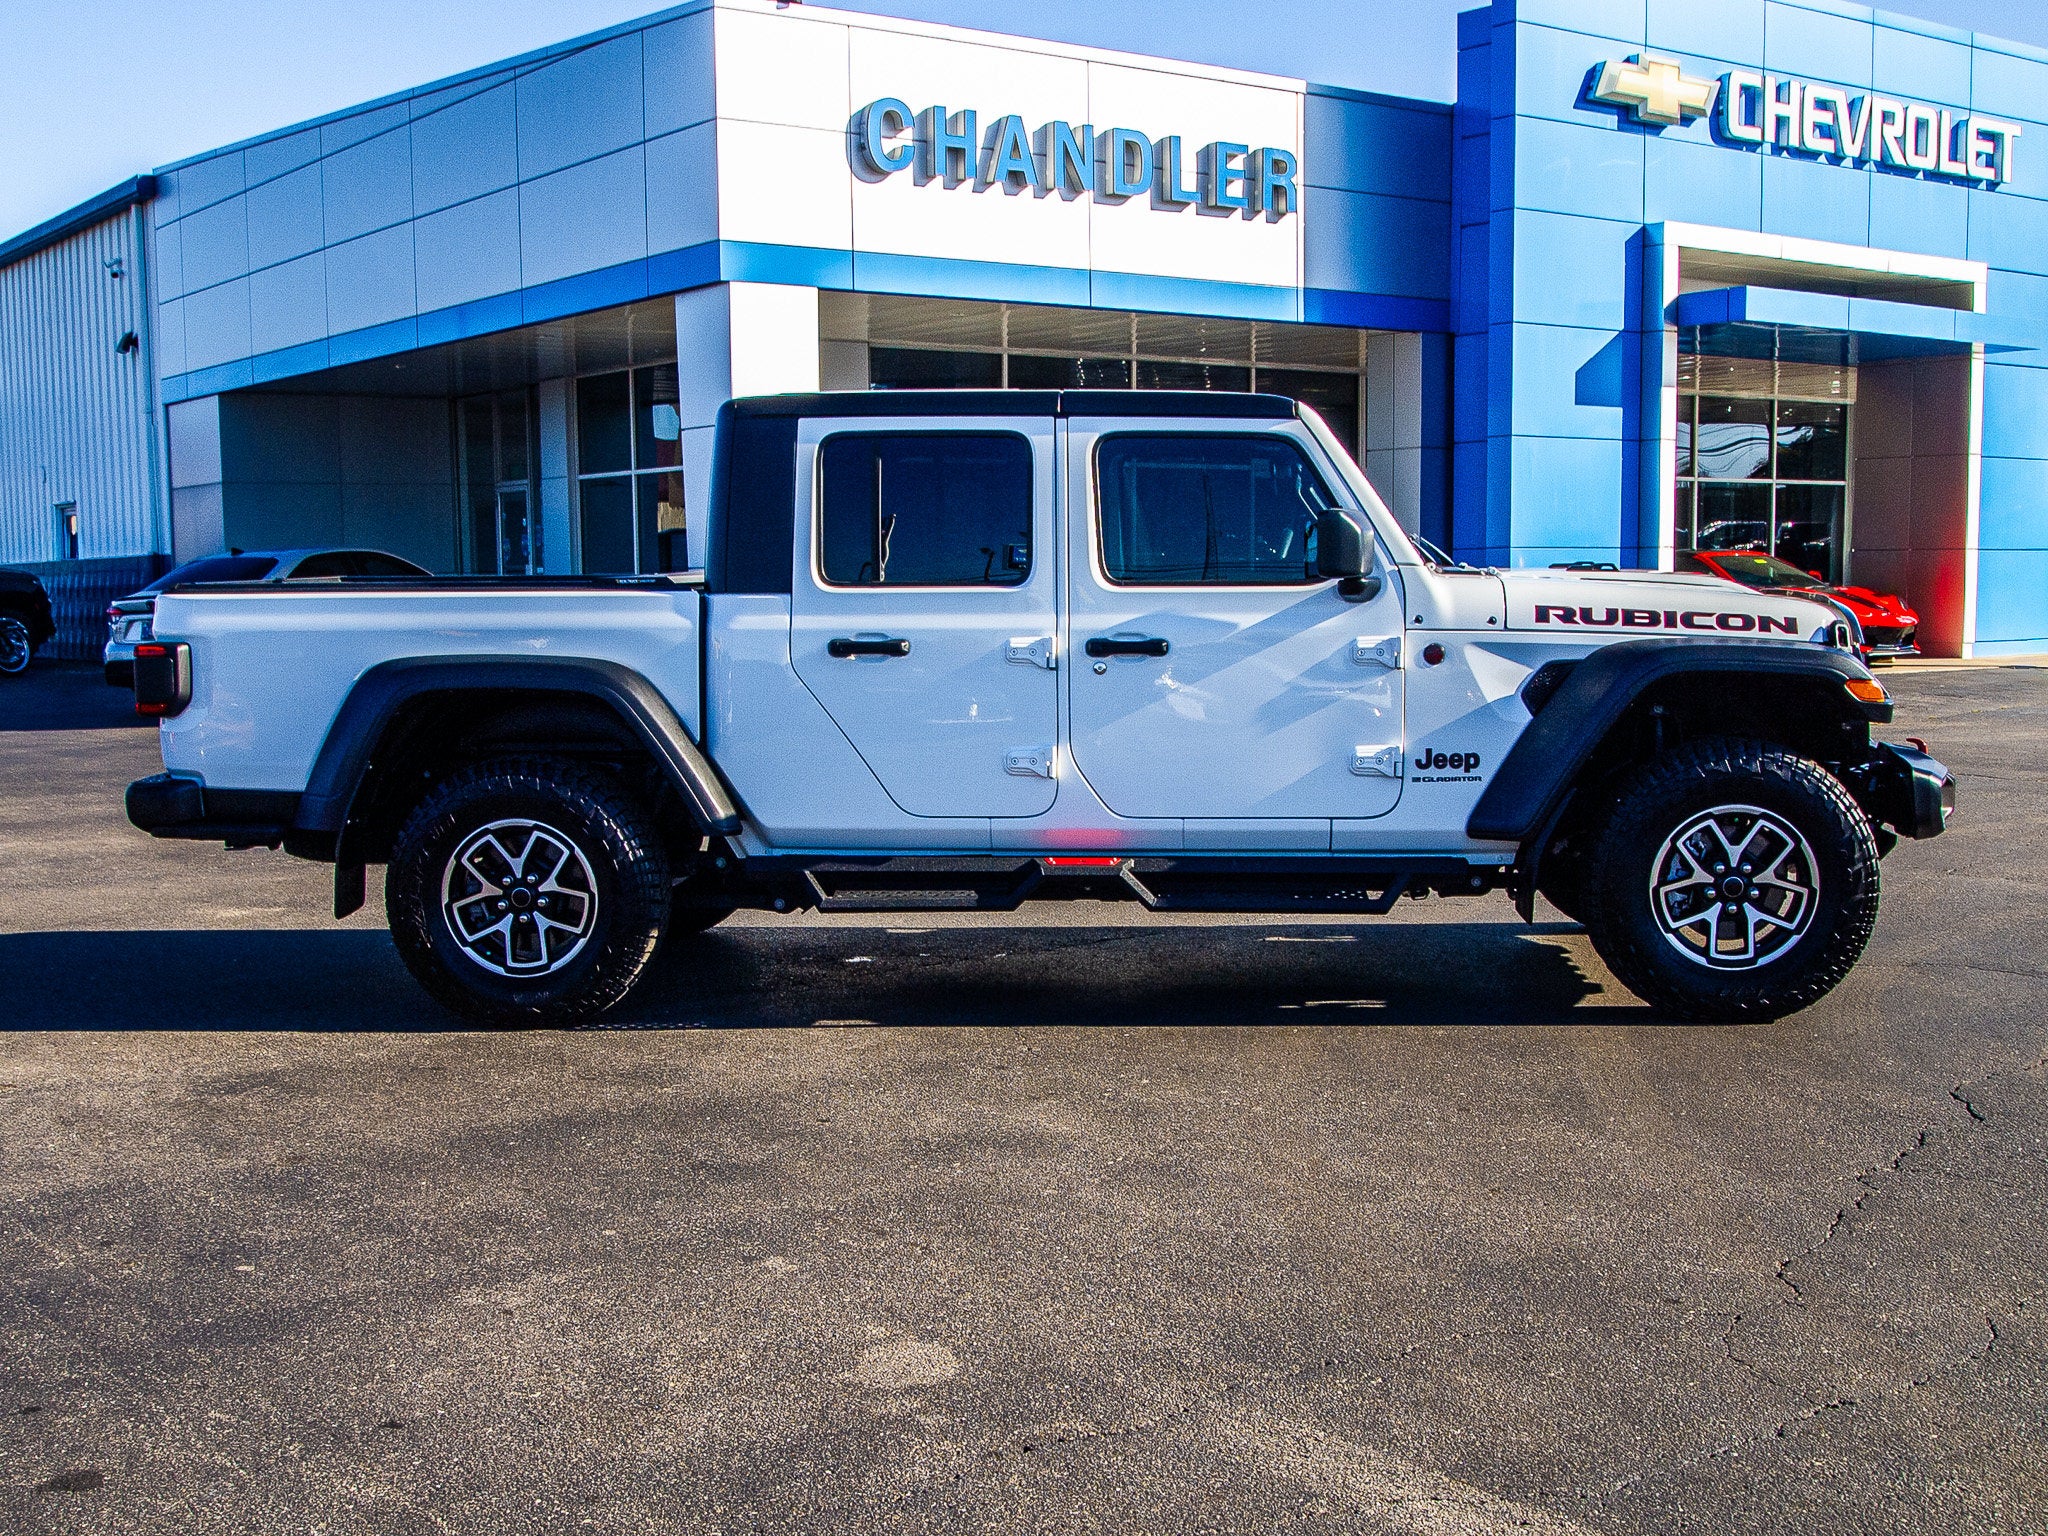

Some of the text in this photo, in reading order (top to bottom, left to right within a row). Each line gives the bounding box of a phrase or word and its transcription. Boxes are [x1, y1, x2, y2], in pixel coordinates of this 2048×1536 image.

[856, 97, 1298, 217] CHANDLER
[1719, 70, 2022, 185] CHEVROLET
[1535, 605, 1798, 634] RUBICON
[1415, 748, 1480, 773] Jeep
